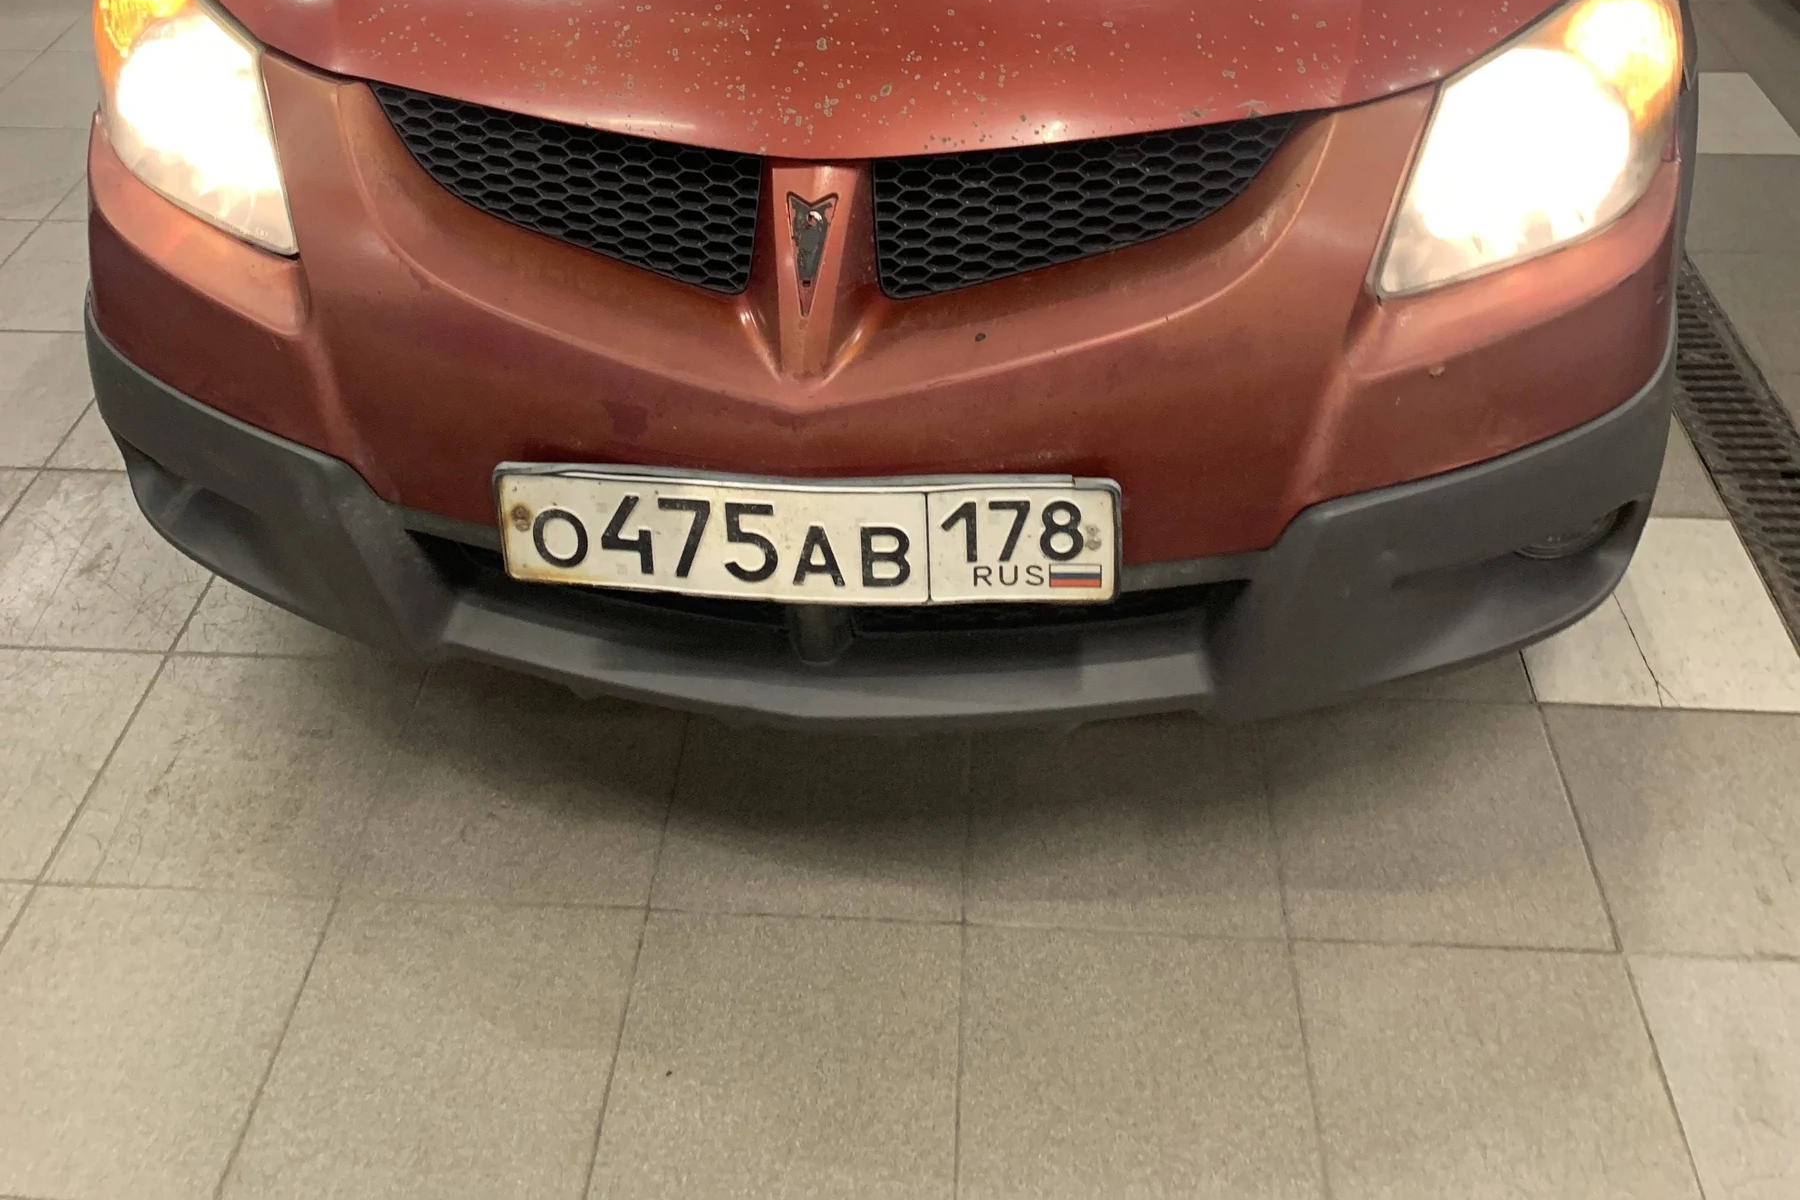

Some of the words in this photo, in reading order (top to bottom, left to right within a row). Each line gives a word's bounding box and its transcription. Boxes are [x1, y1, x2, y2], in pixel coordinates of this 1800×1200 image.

[532, 495, 912, 587] О475АВ
[940, 500, 1085, 563] 178
[973, 565, 1044, 587] RUS
